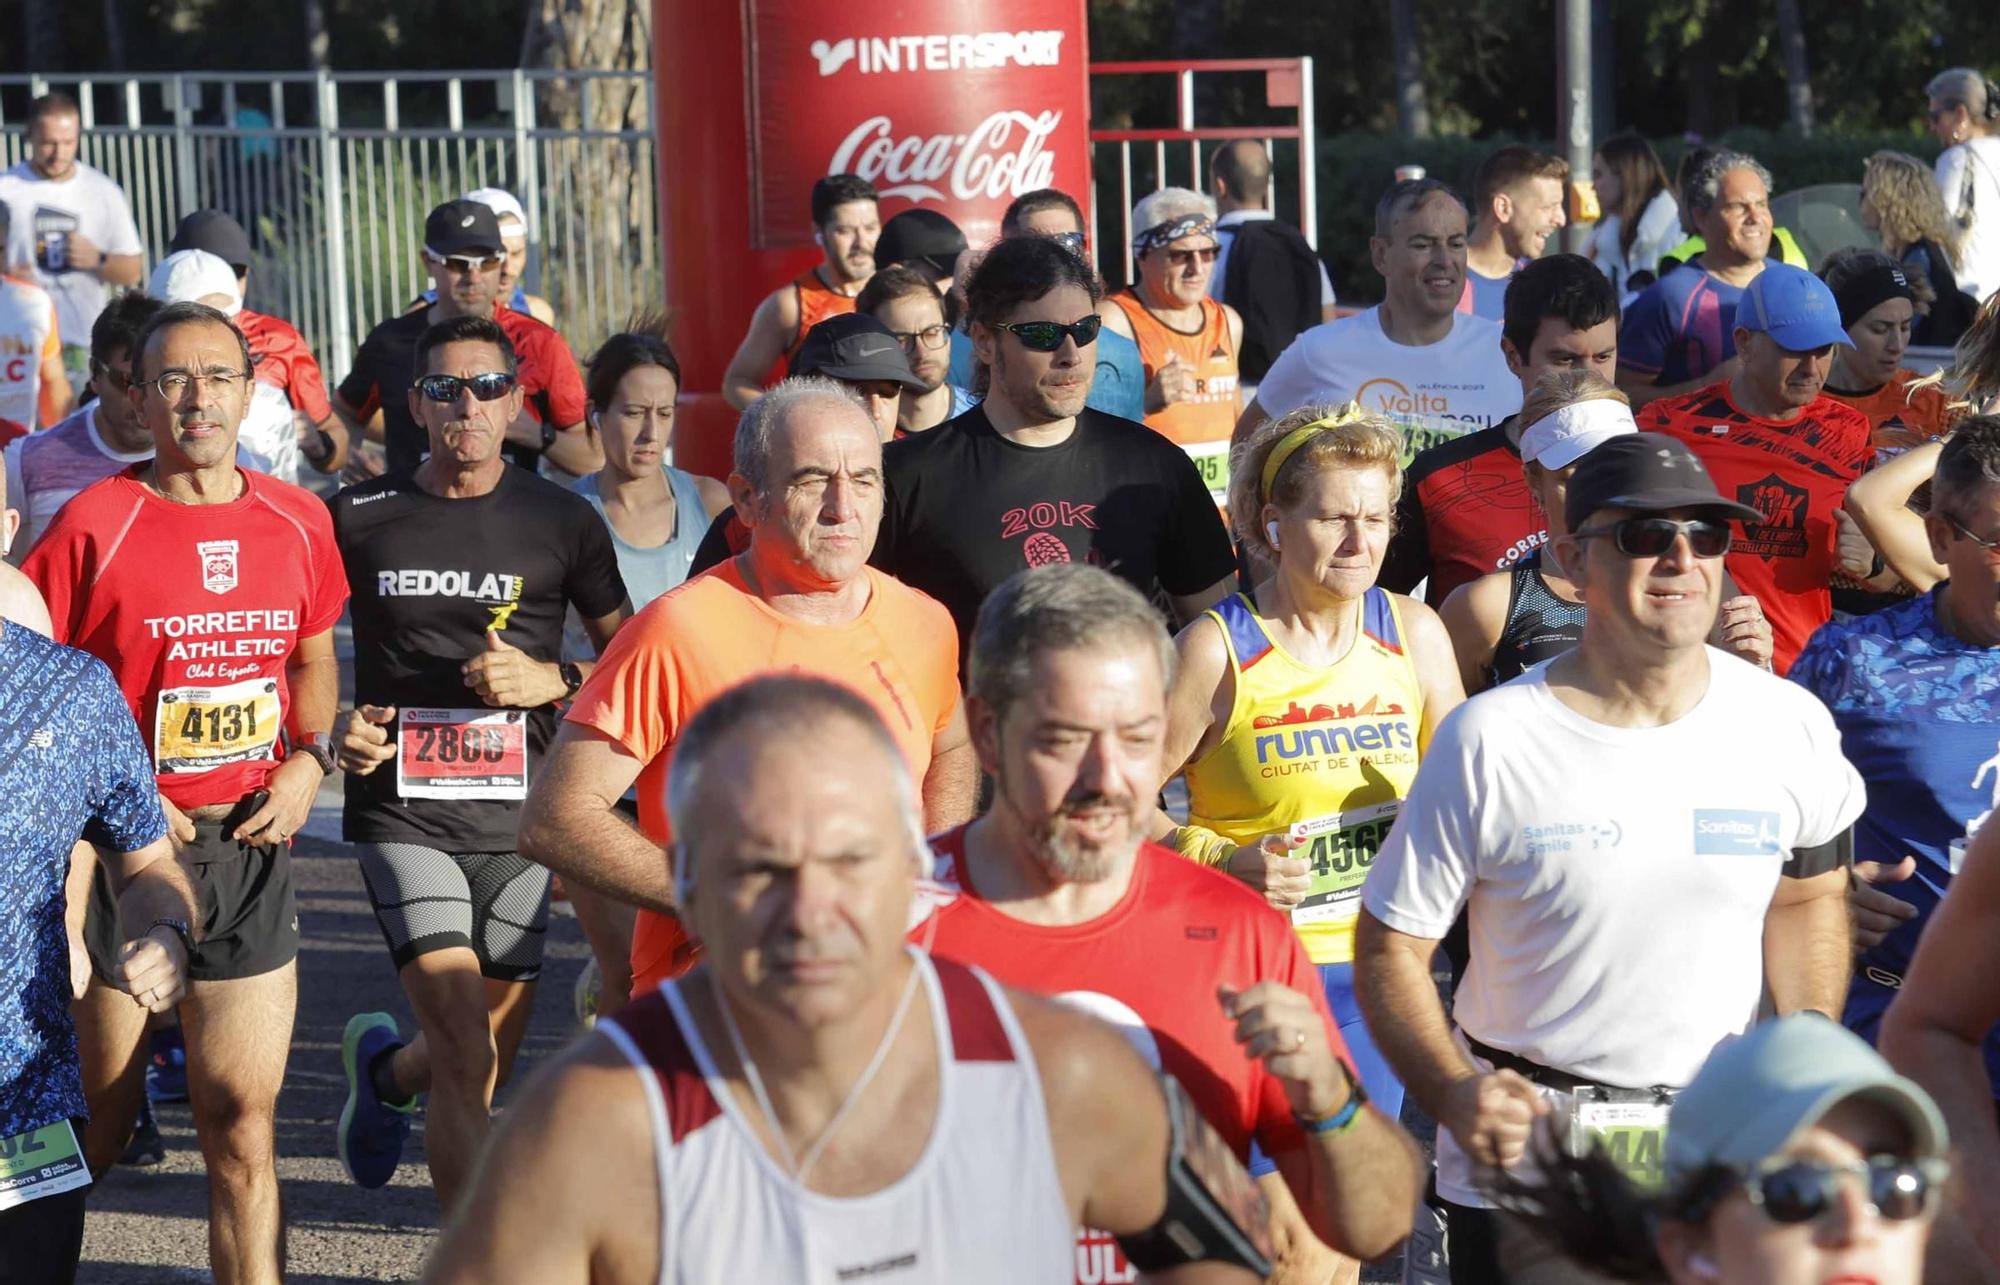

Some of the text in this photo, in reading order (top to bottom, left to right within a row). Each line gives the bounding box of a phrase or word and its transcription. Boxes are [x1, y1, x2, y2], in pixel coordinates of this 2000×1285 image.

[858, 31, 1064, 74] INTERSPORT
[828, 109, 1063, 201] Coca-Cola
[1001, 501, 1100, 539] 20K
[377, 569, 514, 601] REDOLAT
[144, 609, 298, 639] TORREFIEL
[167, 638, 287, 661] ATHLETIC
[186, 662, 215, 679] Club
[181, 700, 257, 744] 4131
[1255, 722, 1412, 764] runners
[1261, 760, 1321, 779] CIUTAT
[1327, 757, 1350, 770] DE
[1523, 823, 1585, 840] Sanitas
[1698, 819, 1757, 836] Sanitas
[1526, 839, 1573, 855] Smile
